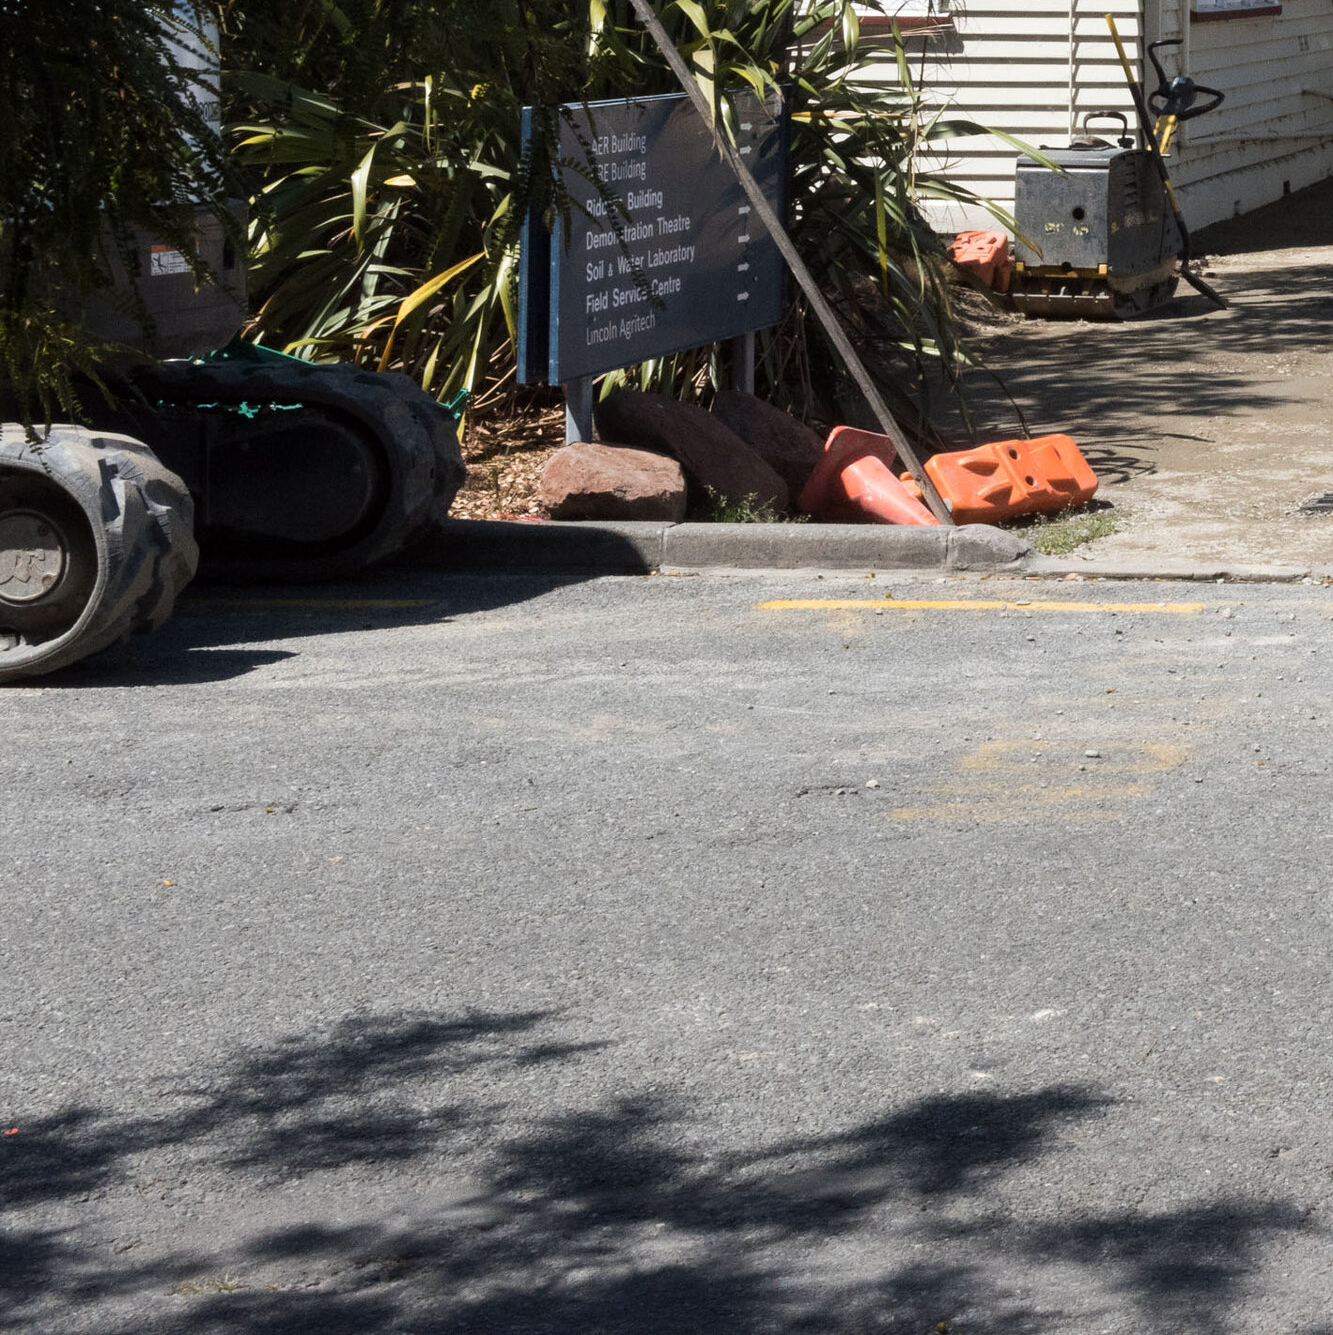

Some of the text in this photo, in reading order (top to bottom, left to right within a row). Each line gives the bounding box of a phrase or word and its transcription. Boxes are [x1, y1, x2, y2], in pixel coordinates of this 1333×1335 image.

[611, 132, 647, 154] Building
[611, 159, 647, 181] Building
[627, 189, 663, 210] Building
[657, 214, 691, 235] Theatre
[586, 260, 605, 282] Soil
[607, 263, 614, 277] &
[647, 245, 696, 268] Laboratory
[586, 290, 609, 314] Field
[586, 309, 656, 346] Lincoln Agritech
